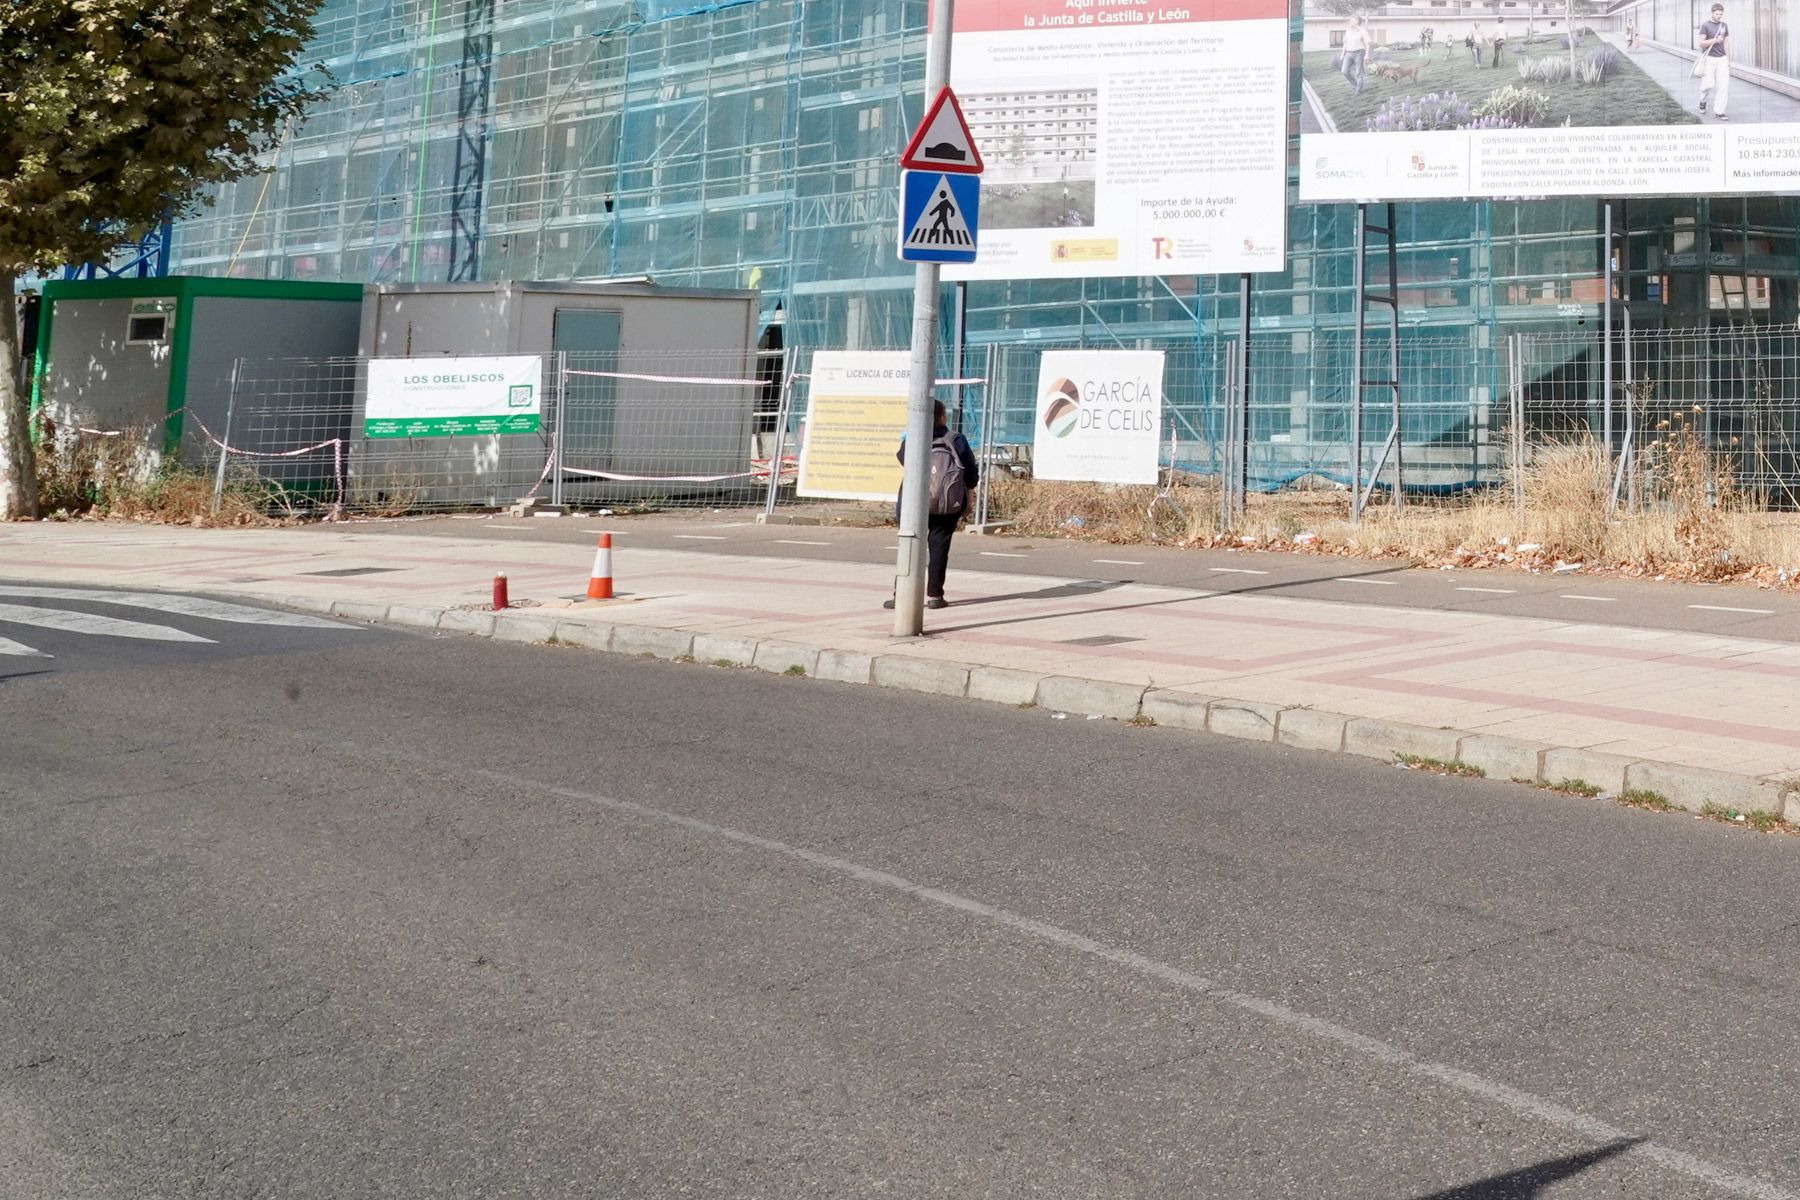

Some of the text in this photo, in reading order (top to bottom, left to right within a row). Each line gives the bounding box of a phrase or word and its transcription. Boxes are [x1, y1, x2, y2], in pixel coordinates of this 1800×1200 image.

[1024, 6, 1190, 27] la Junta de Castilla y León
[1097, 40, 1126, 48] Vivienda
[1134, 37, 1175, 46] Ordenación
[1190, 35, 1224, 43] Territorio
[1482, 136, 1537, 144] CONSTRUCCIÓN
[1608, 134, 1665, 142] COLABORATIVAS
[1482, 158, 1541, 166] PRINCIPALMENTE
[1315, 170, 1365, 179] SOMACYL
[1633, 167, 1655, 175] SANTA
[1659, 166, 1681, 174] MARÍA
[1733, 169, 1751, 178] Más
[1141, 196, 1237, 208] Importe de la Ayuda:
[1153, 208, 1225, 219] 5.000.000,00 €
[404, 373, 505, 384] LOS OBELISCOS
[846, 369, 881, 378] LICENCIA
[882, 370, 893, 378] DE
[895, 370, 911, 378] OBR
[1083, 376, 1152, 403] GARCÍA
[1080, 409, 1153, 431] DE CELIS
